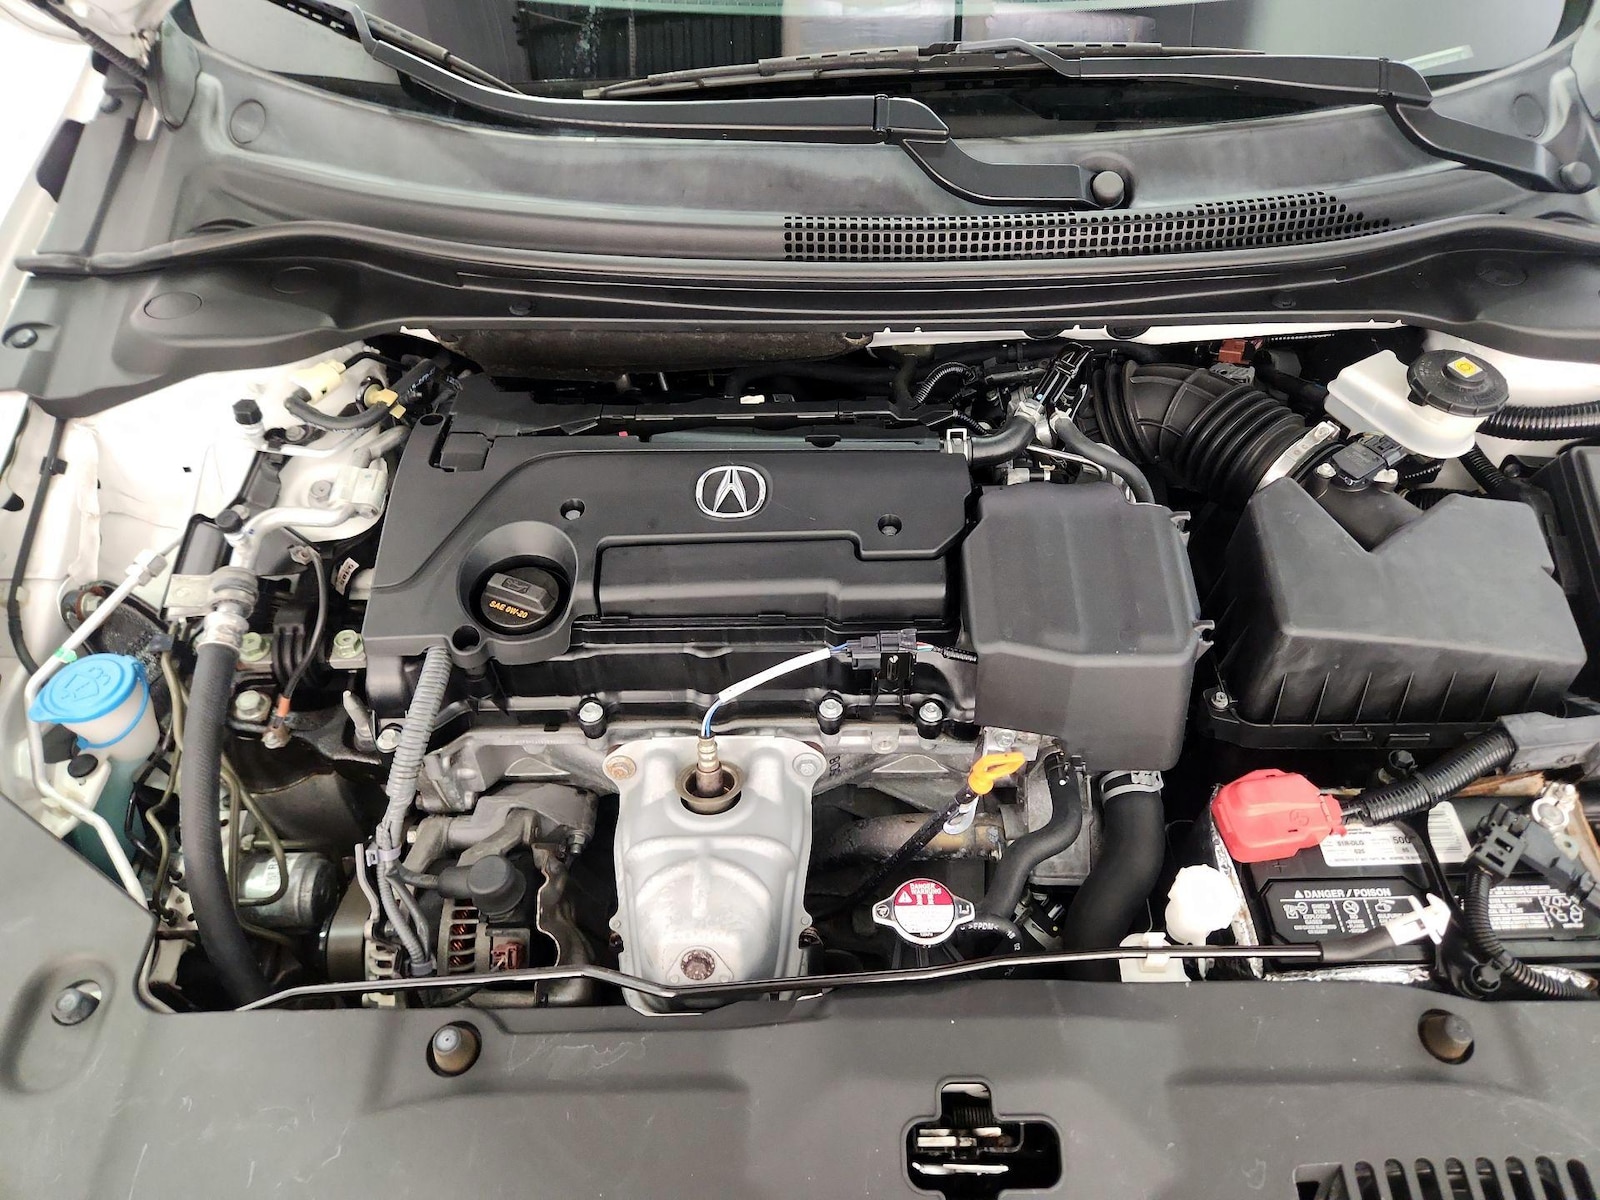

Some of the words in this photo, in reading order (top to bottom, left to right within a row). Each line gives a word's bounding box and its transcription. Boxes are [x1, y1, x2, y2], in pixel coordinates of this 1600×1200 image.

[489, 600, 506, 611] SAE
[505, 606, 529, 619] 0W-20
[1393, 836, 1411, 844] 500
[1303, 889, 1345, 899] DANGER
[1354, 888, 1392, 897] POISON
